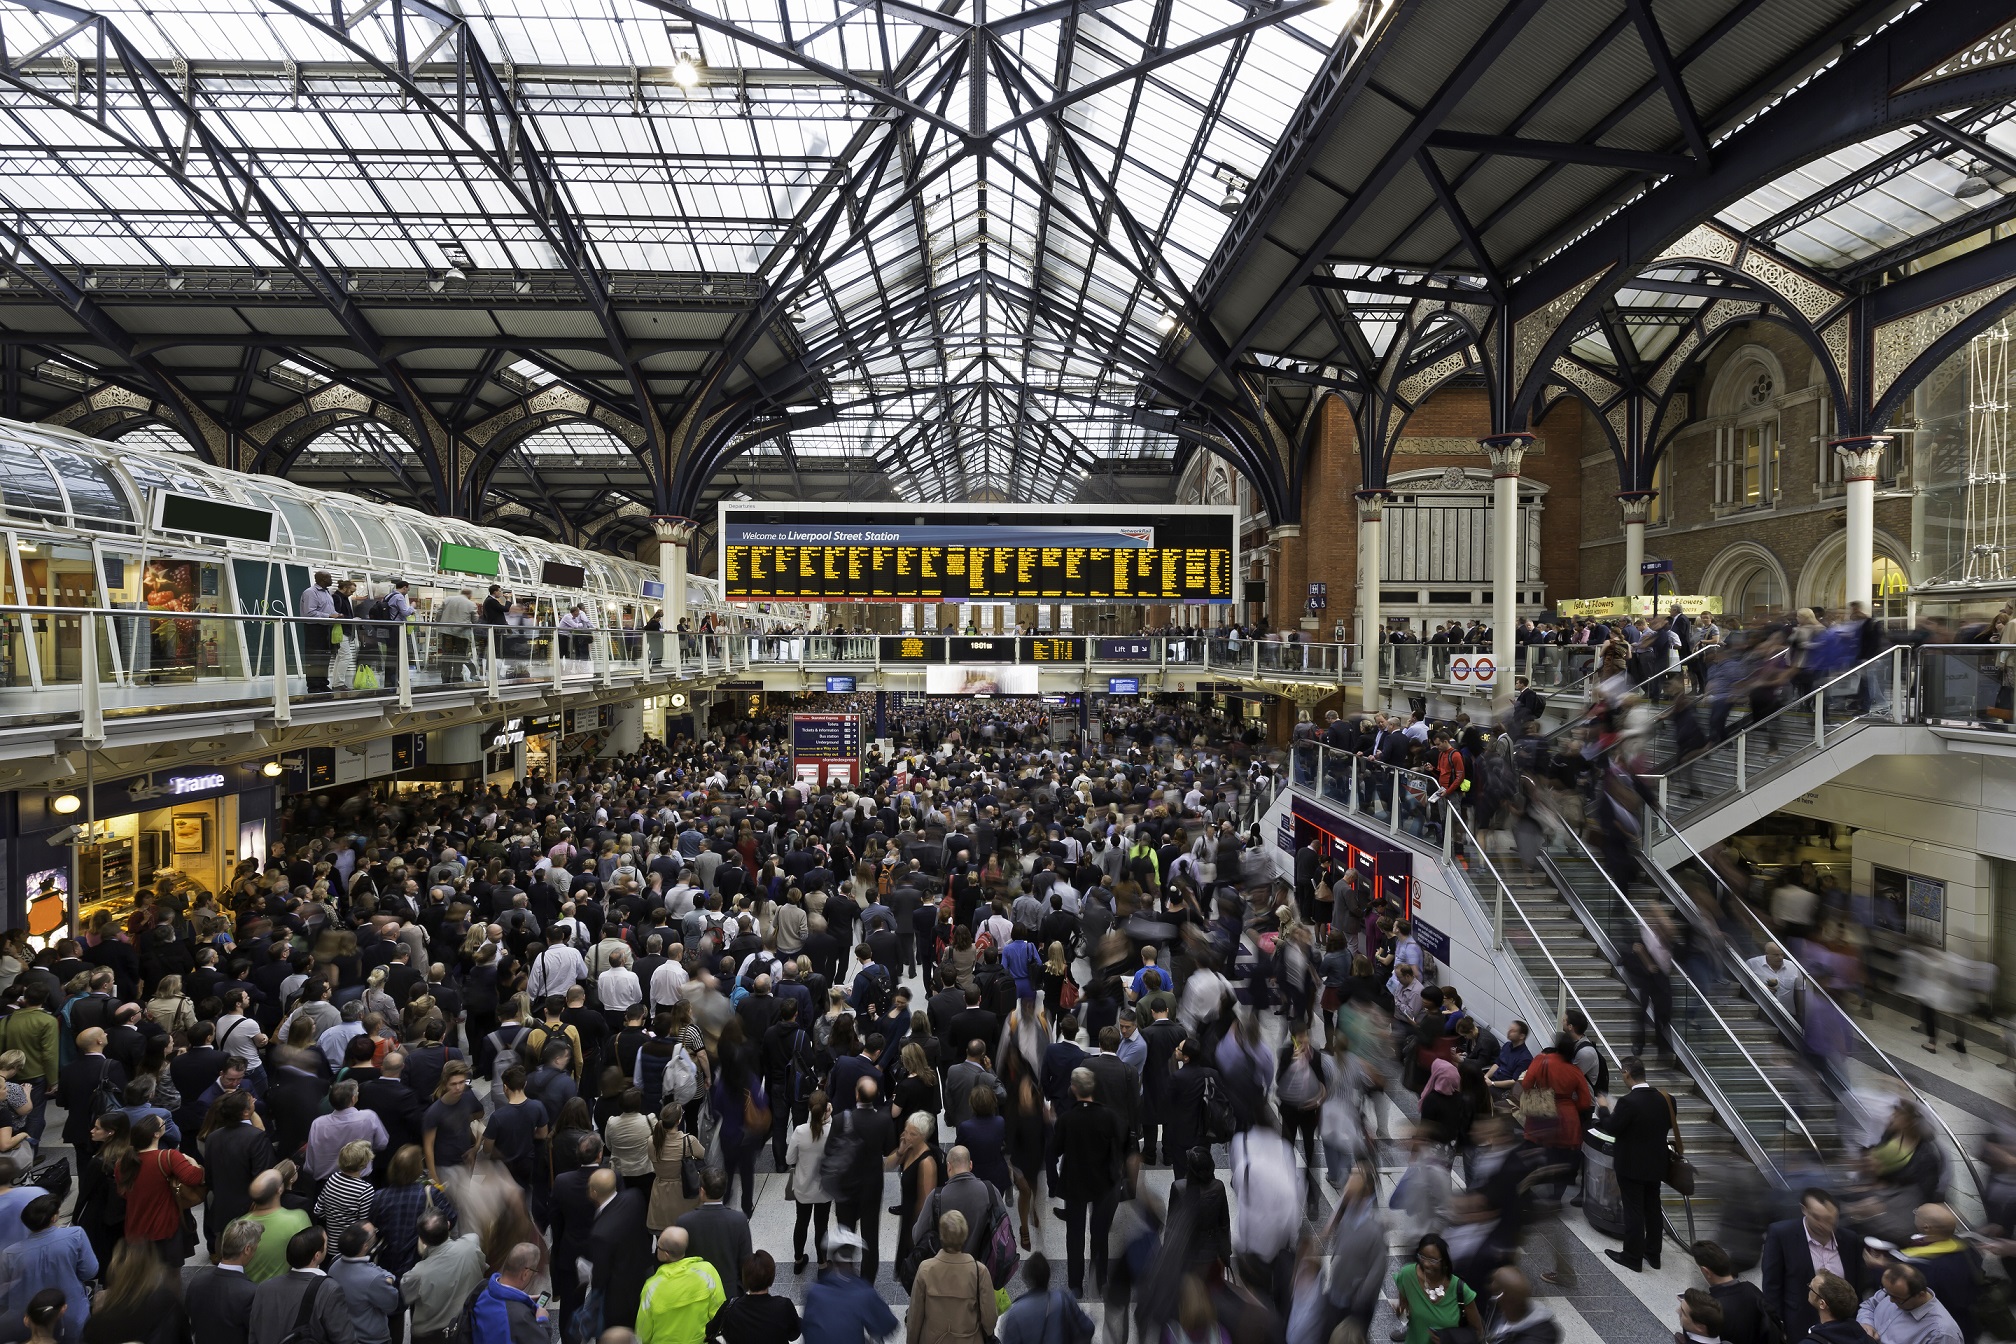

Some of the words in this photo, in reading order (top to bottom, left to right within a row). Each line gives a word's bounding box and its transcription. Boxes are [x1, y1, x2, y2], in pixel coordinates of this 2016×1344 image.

[742, 531, 777, 540] Welcome
[778, 532, 787, 540] to
[788, 530, 832, 543] Liverpool
[833, 531, 863, 541] Street
[865, 531, 900, 541] Station
[1573, 600, 1584, 610] Isle
[1592, 600, 1615, 608] Flowers
[1650, 598, 1664, 606] Ise
[1676, 598, 1704, 606] Flowers
[1114, 645, 1126, 653] Lift
[417, 735, 424, 752] 5
[173, 774, 225, 794] France
